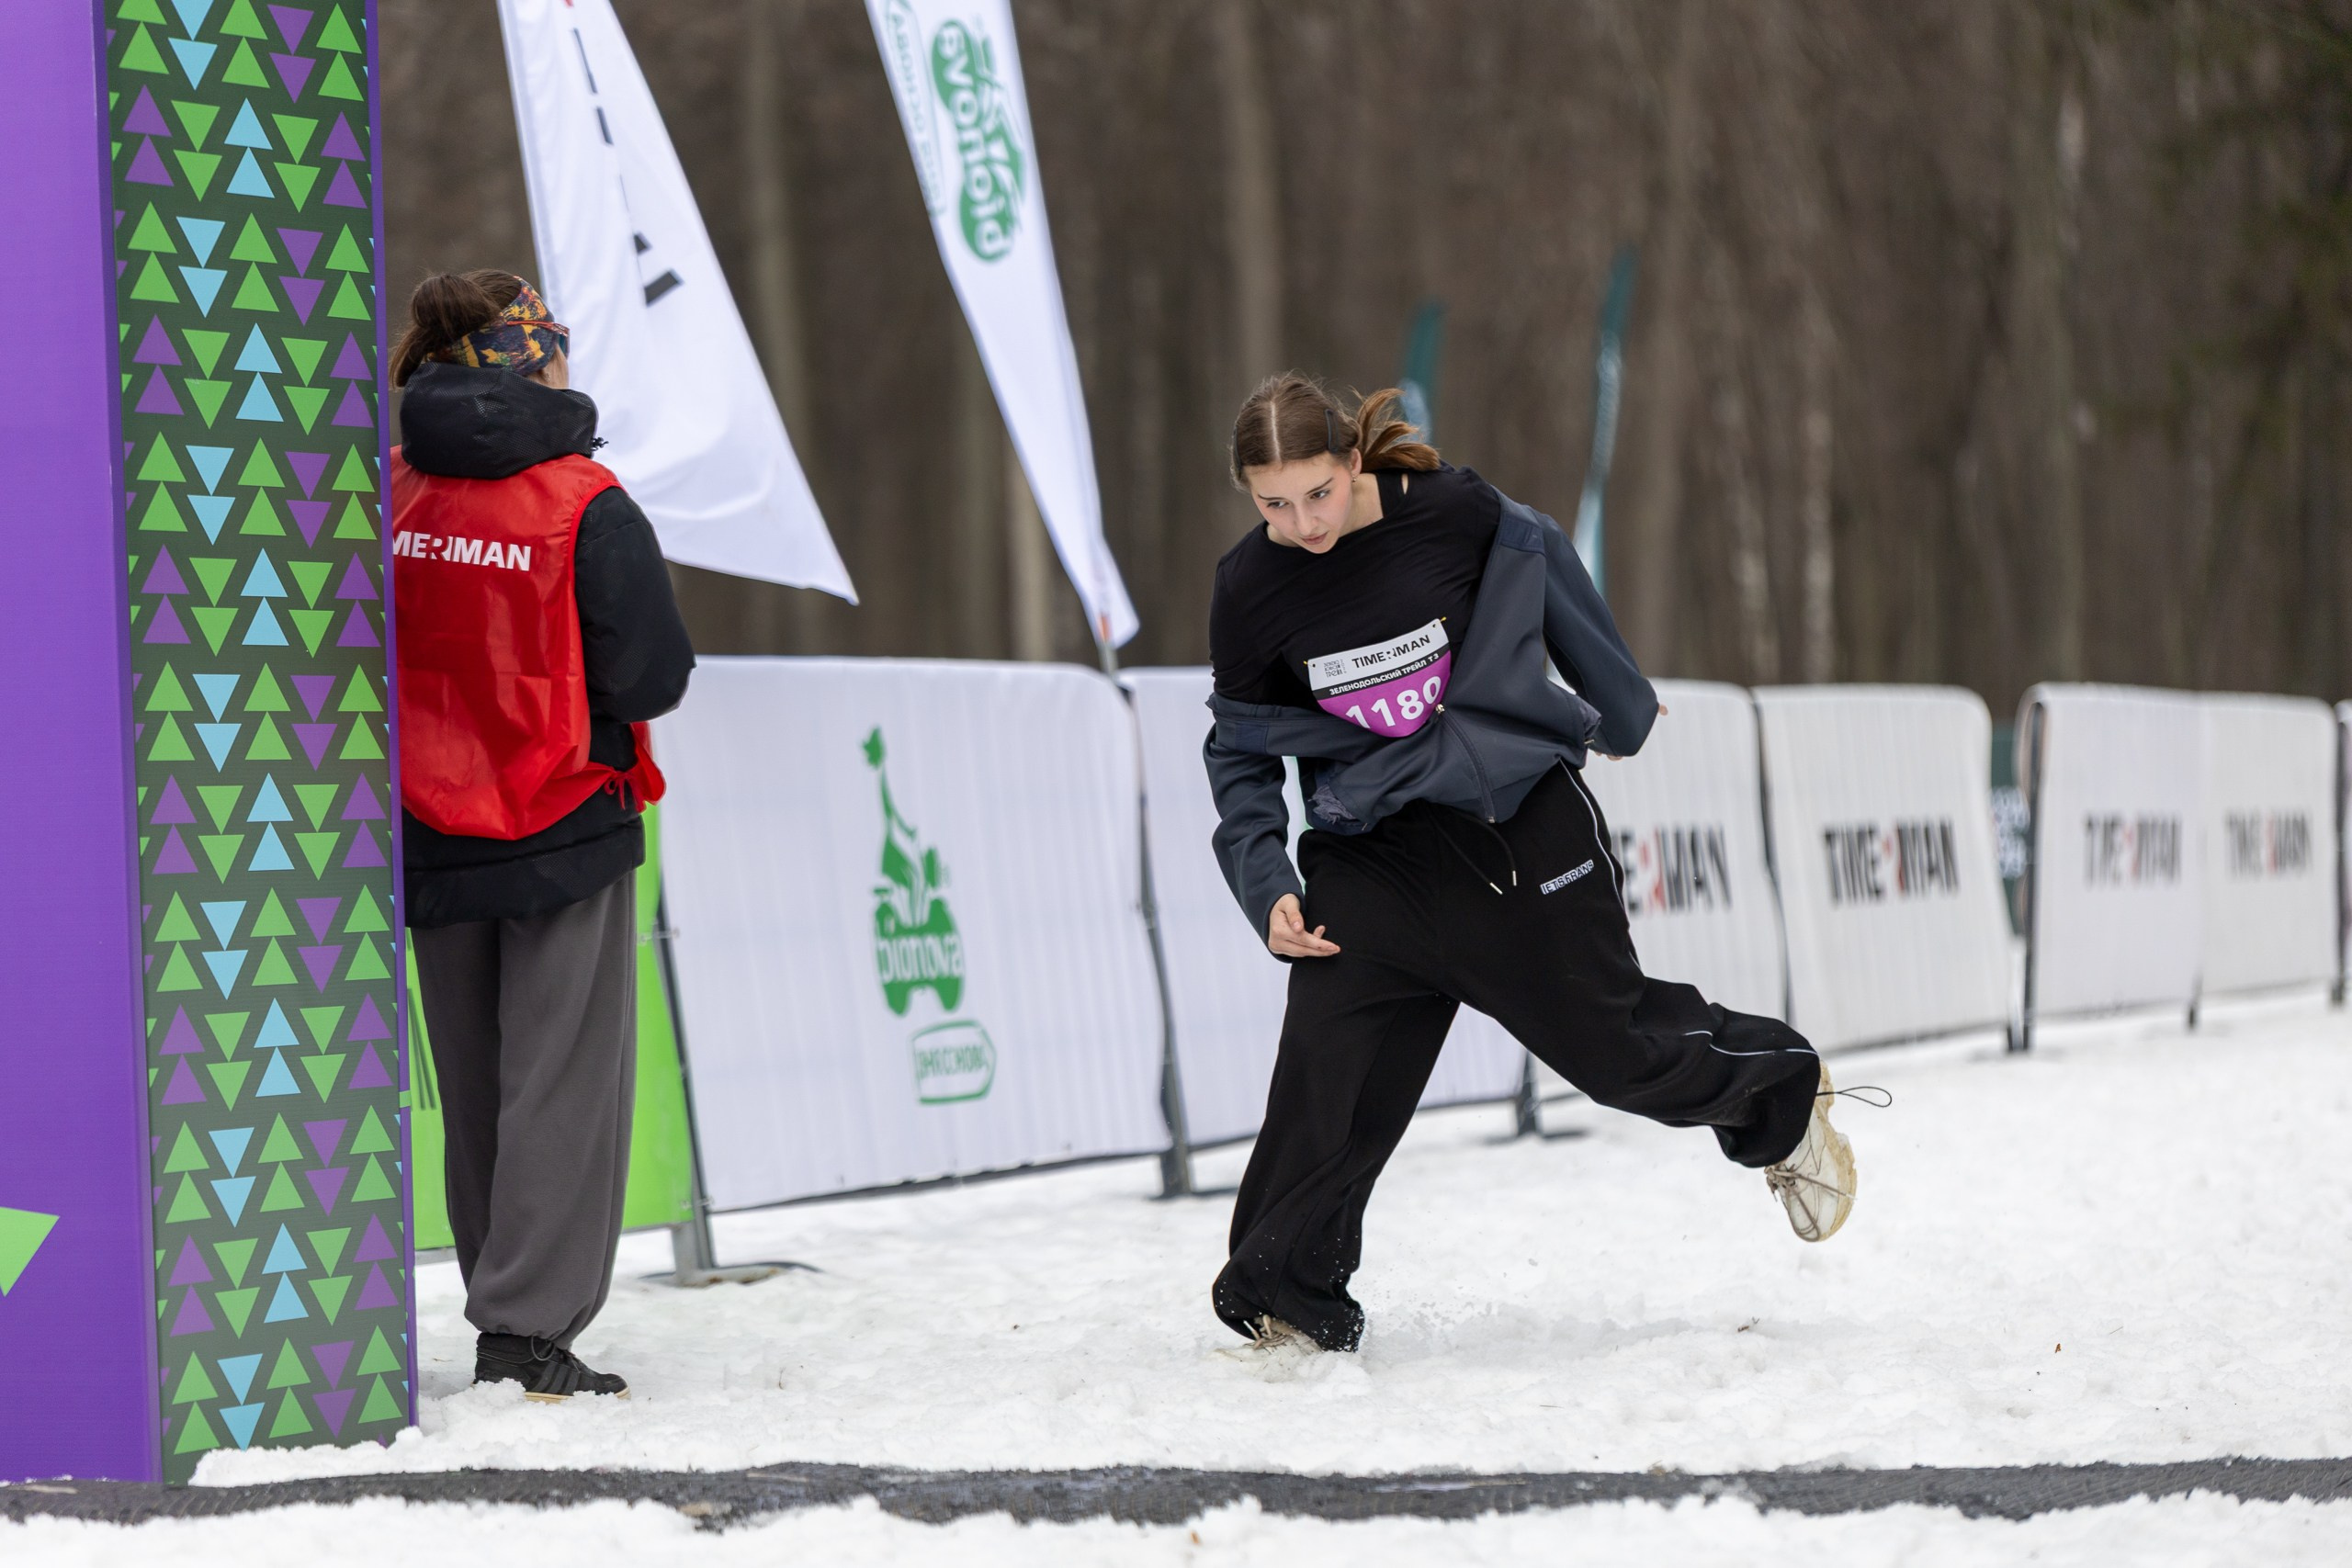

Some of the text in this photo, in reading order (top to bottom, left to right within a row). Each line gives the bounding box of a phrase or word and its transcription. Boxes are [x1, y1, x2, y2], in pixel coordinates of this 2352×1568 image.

[392, 530, 531, 571] MERMAN
[1329, 669, 1402, 695] ЗЕЛЕНОДОЛЬСКИЙ
[1402, 660, 1427, 675] ТРЕЙЛ
[1345, 676, 1442, 728] 1180
